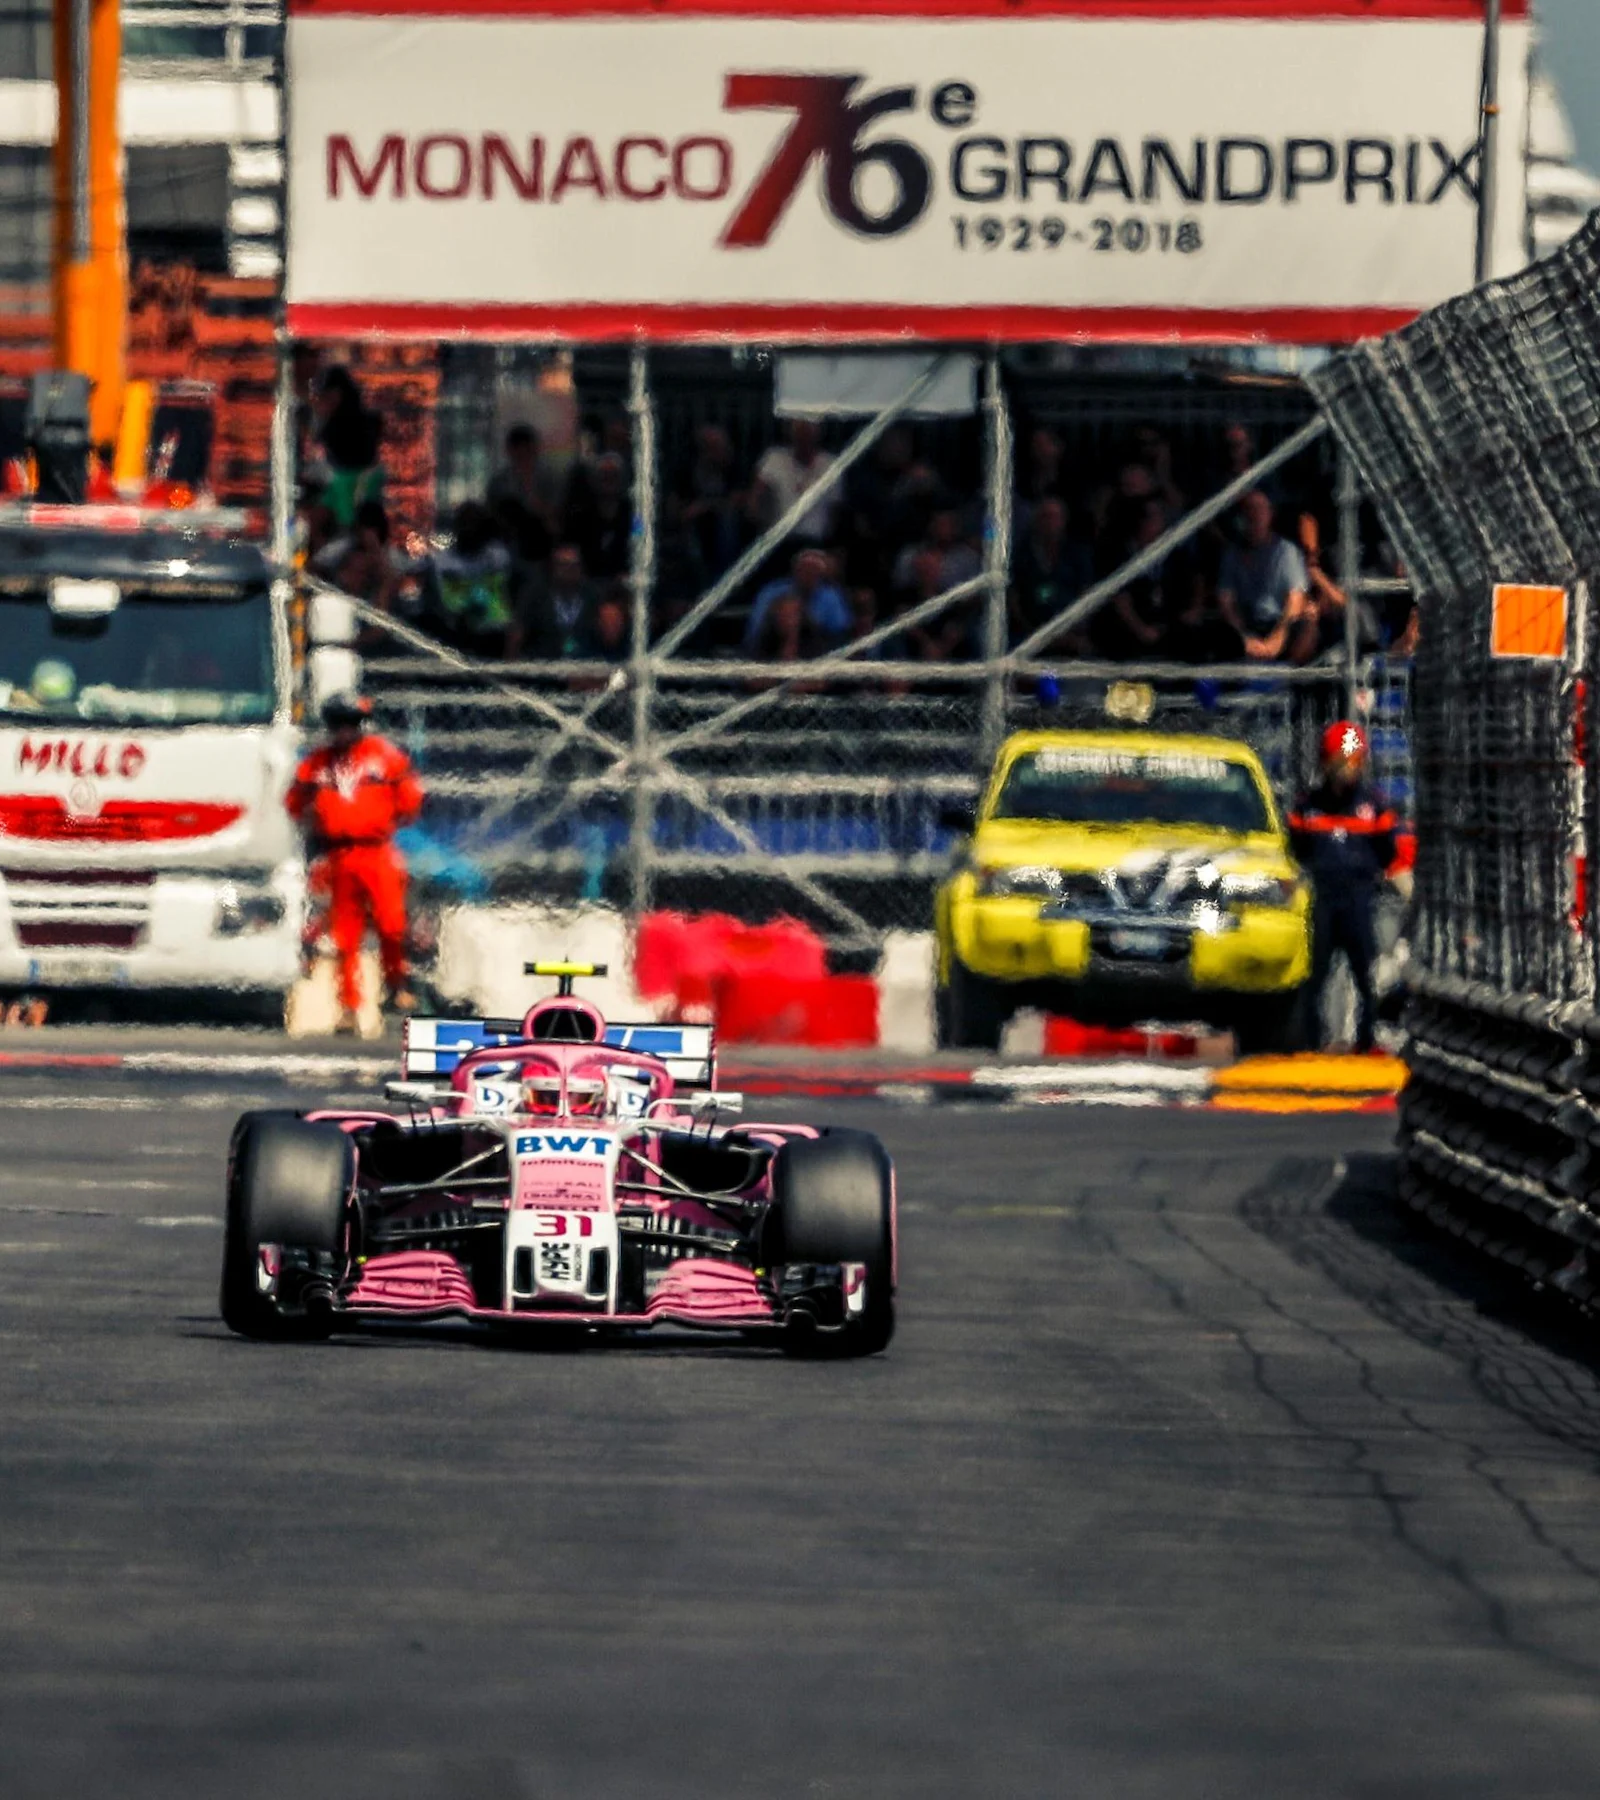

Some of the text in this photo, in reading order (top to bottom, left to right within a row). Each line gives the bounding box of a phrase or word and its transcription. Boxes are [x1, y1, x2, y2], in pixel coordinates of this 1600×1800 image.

[326, 133, 733, 204] MONACO
[951, 215, 1203, 254] 1929-2018
[516, 1136, 612, 1155] BWT
[533, 1213, 592, 1237] 31
